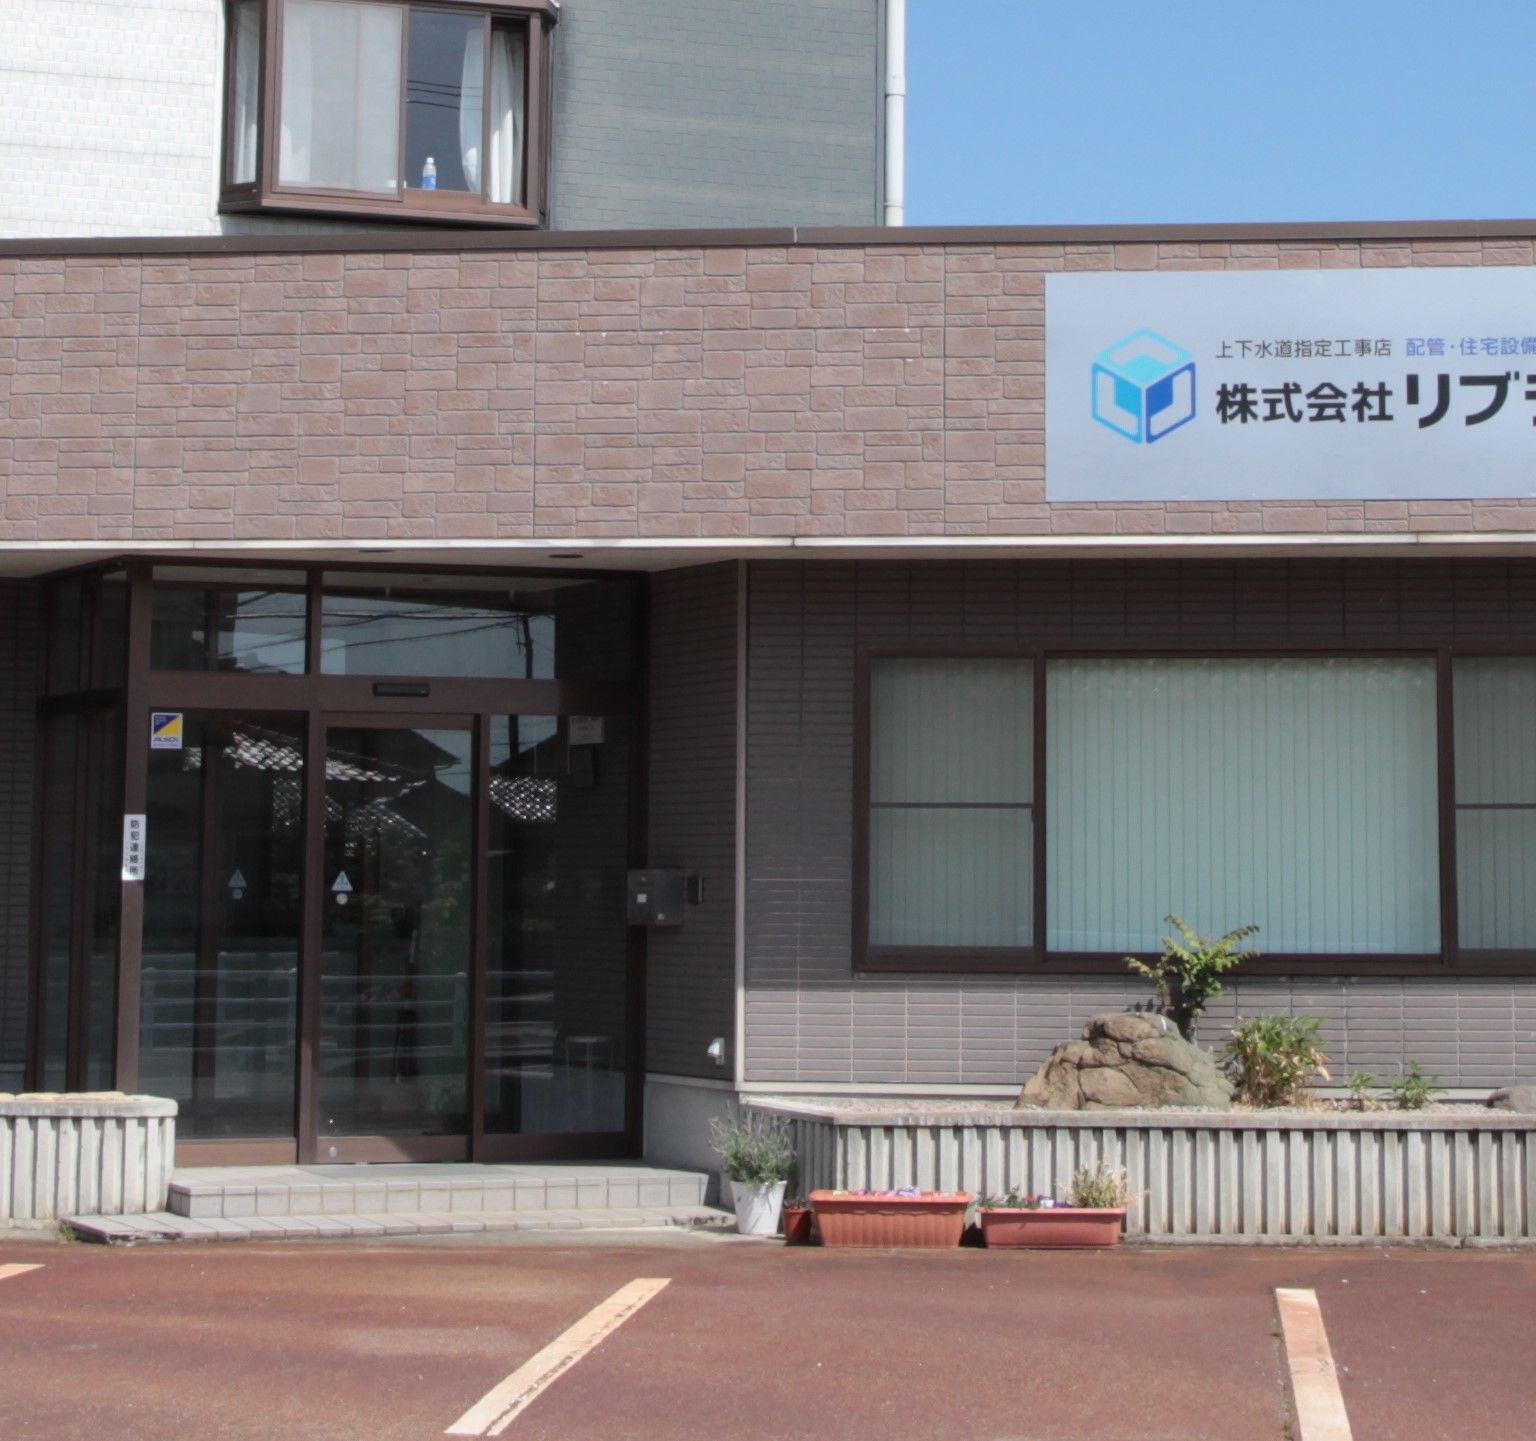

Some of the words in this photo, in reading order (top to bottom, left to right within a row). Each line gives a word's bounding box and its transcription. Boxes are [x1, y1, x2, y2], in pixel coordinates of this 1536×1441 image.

[1215, 338, 1392, 358] 上下水道指定工事店
